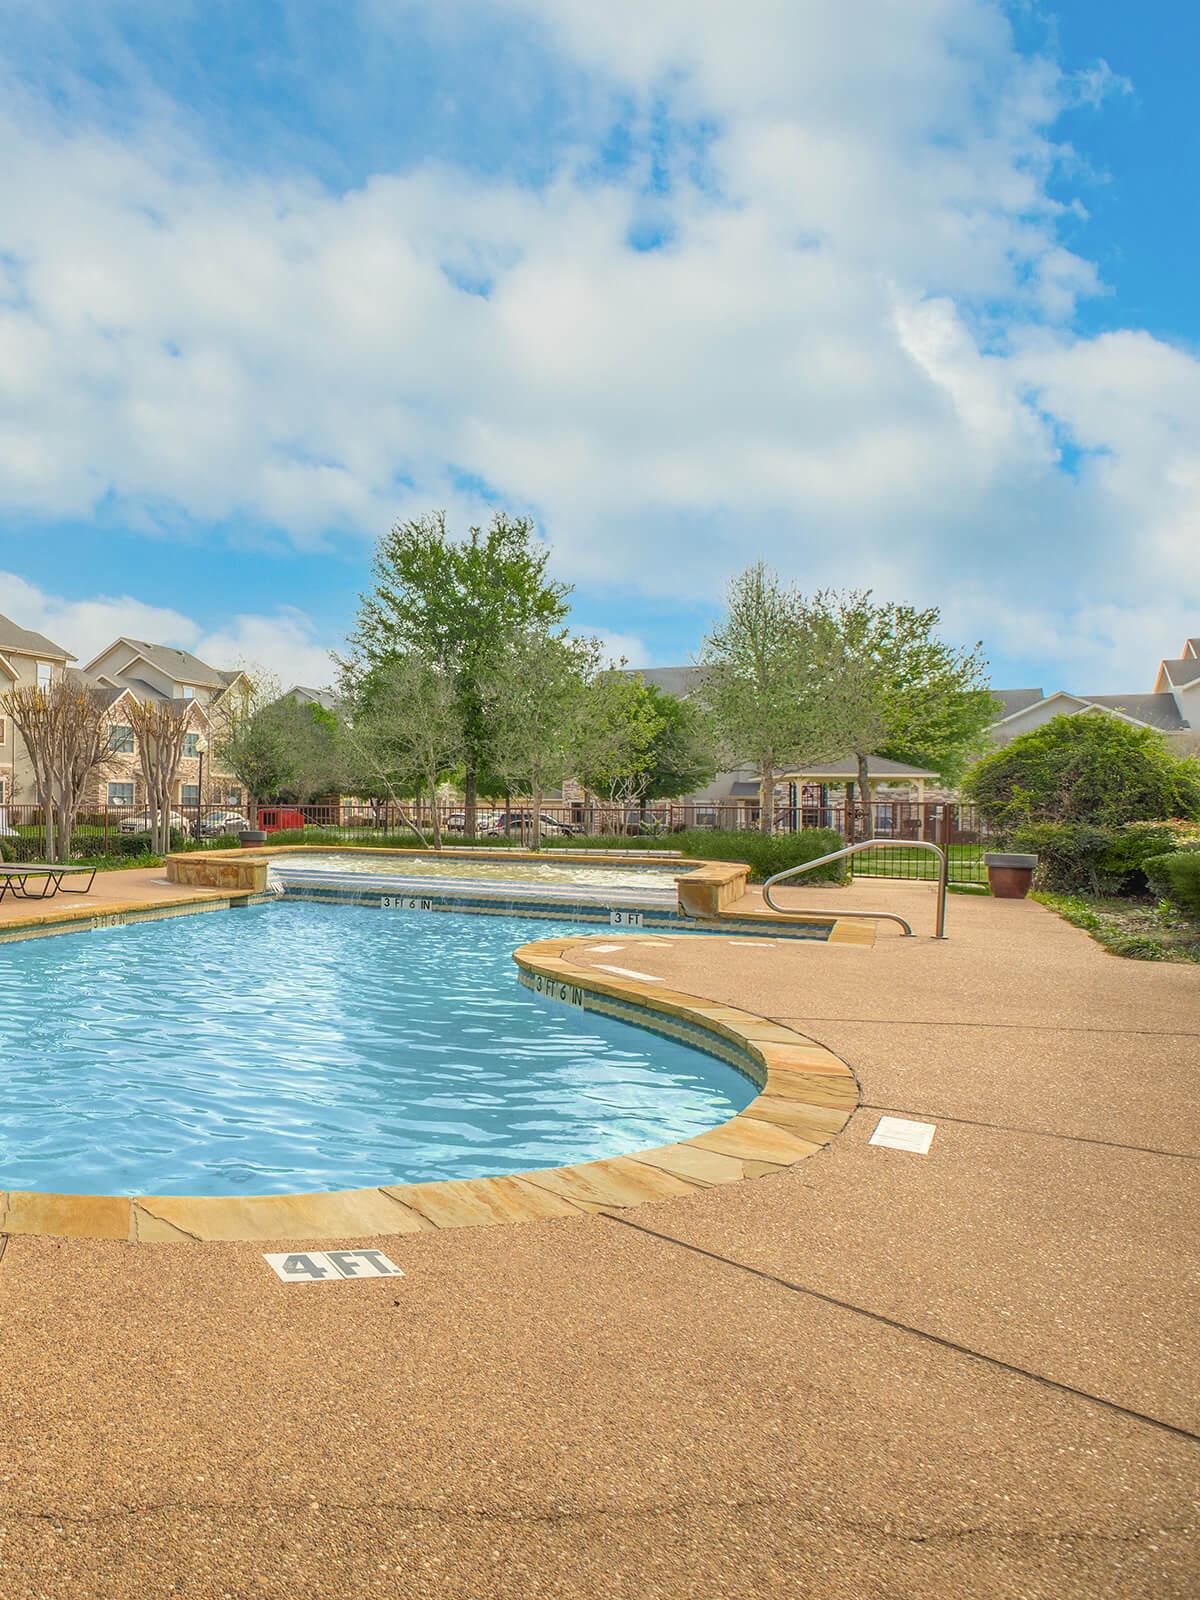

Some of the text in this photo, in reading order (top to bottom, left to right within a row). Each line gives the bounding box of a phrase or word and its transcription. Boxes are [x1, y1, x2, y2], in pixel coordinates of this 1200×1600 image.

[384, 897, 390, 907] 3
[409, 900, 416, 909] 6
[421, 900, 430, 910] IN
[614, 912, 640, 925] 3 FT
[536, 976, 582, 1006] 3 FT 6 IN
[282, 1253, 328, 1279] 4
